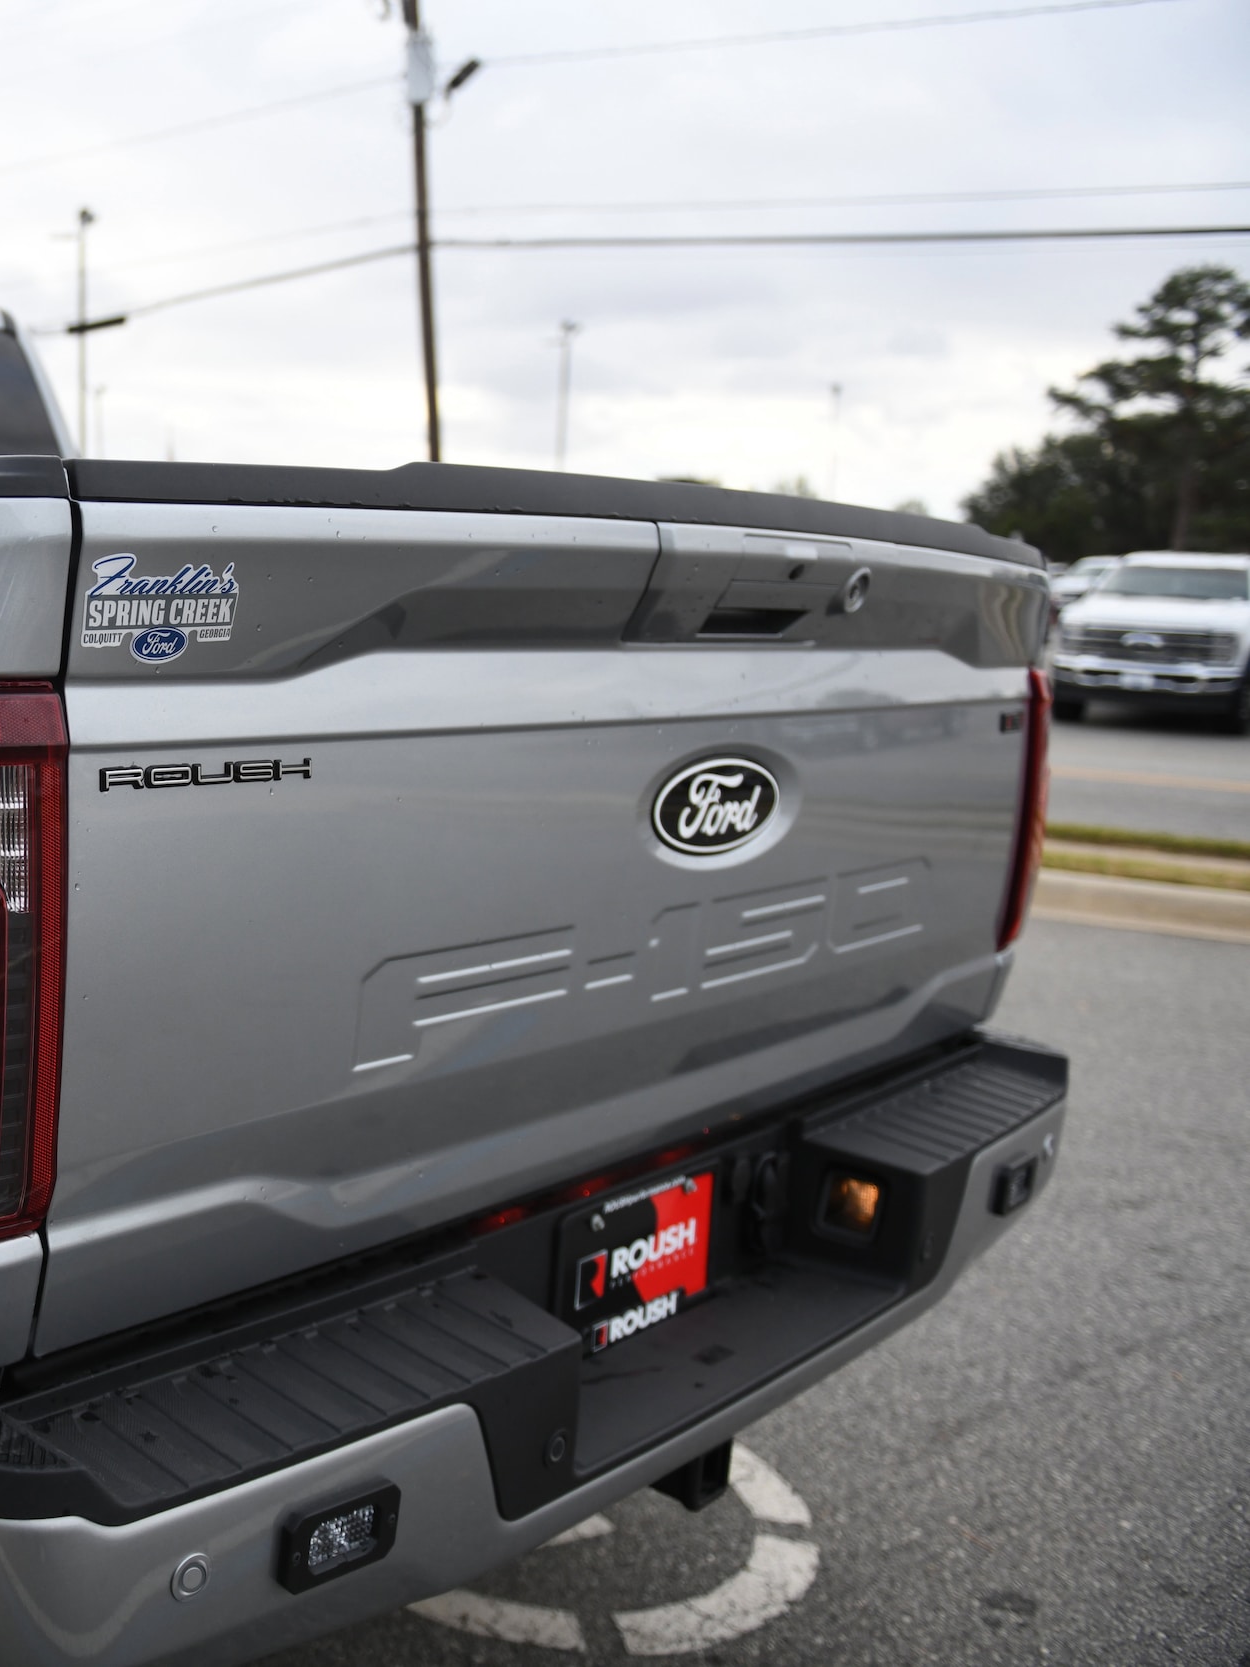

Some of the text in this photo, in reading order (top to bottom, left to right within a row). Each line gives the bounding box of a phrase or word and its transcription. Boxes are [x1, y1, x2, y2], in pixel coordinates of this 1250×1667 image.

[89, 555, 238, 599] Franklin's
[88, 598, 234, 628] SPRING CREEK
[199, 627, 231, 639] GEORGIA
[83, 632, 123, 646] COLQUITT
[141, 631, 179, 656] Ford
[99, 757, 312, 793] ROUSH
[677, 771, 762, 840] Ford
[352, 855, 932, 1072] F-150
[611, 1218, 696, 1278] ROUSH
[609, 1292, 678, 1342] ROUSH
